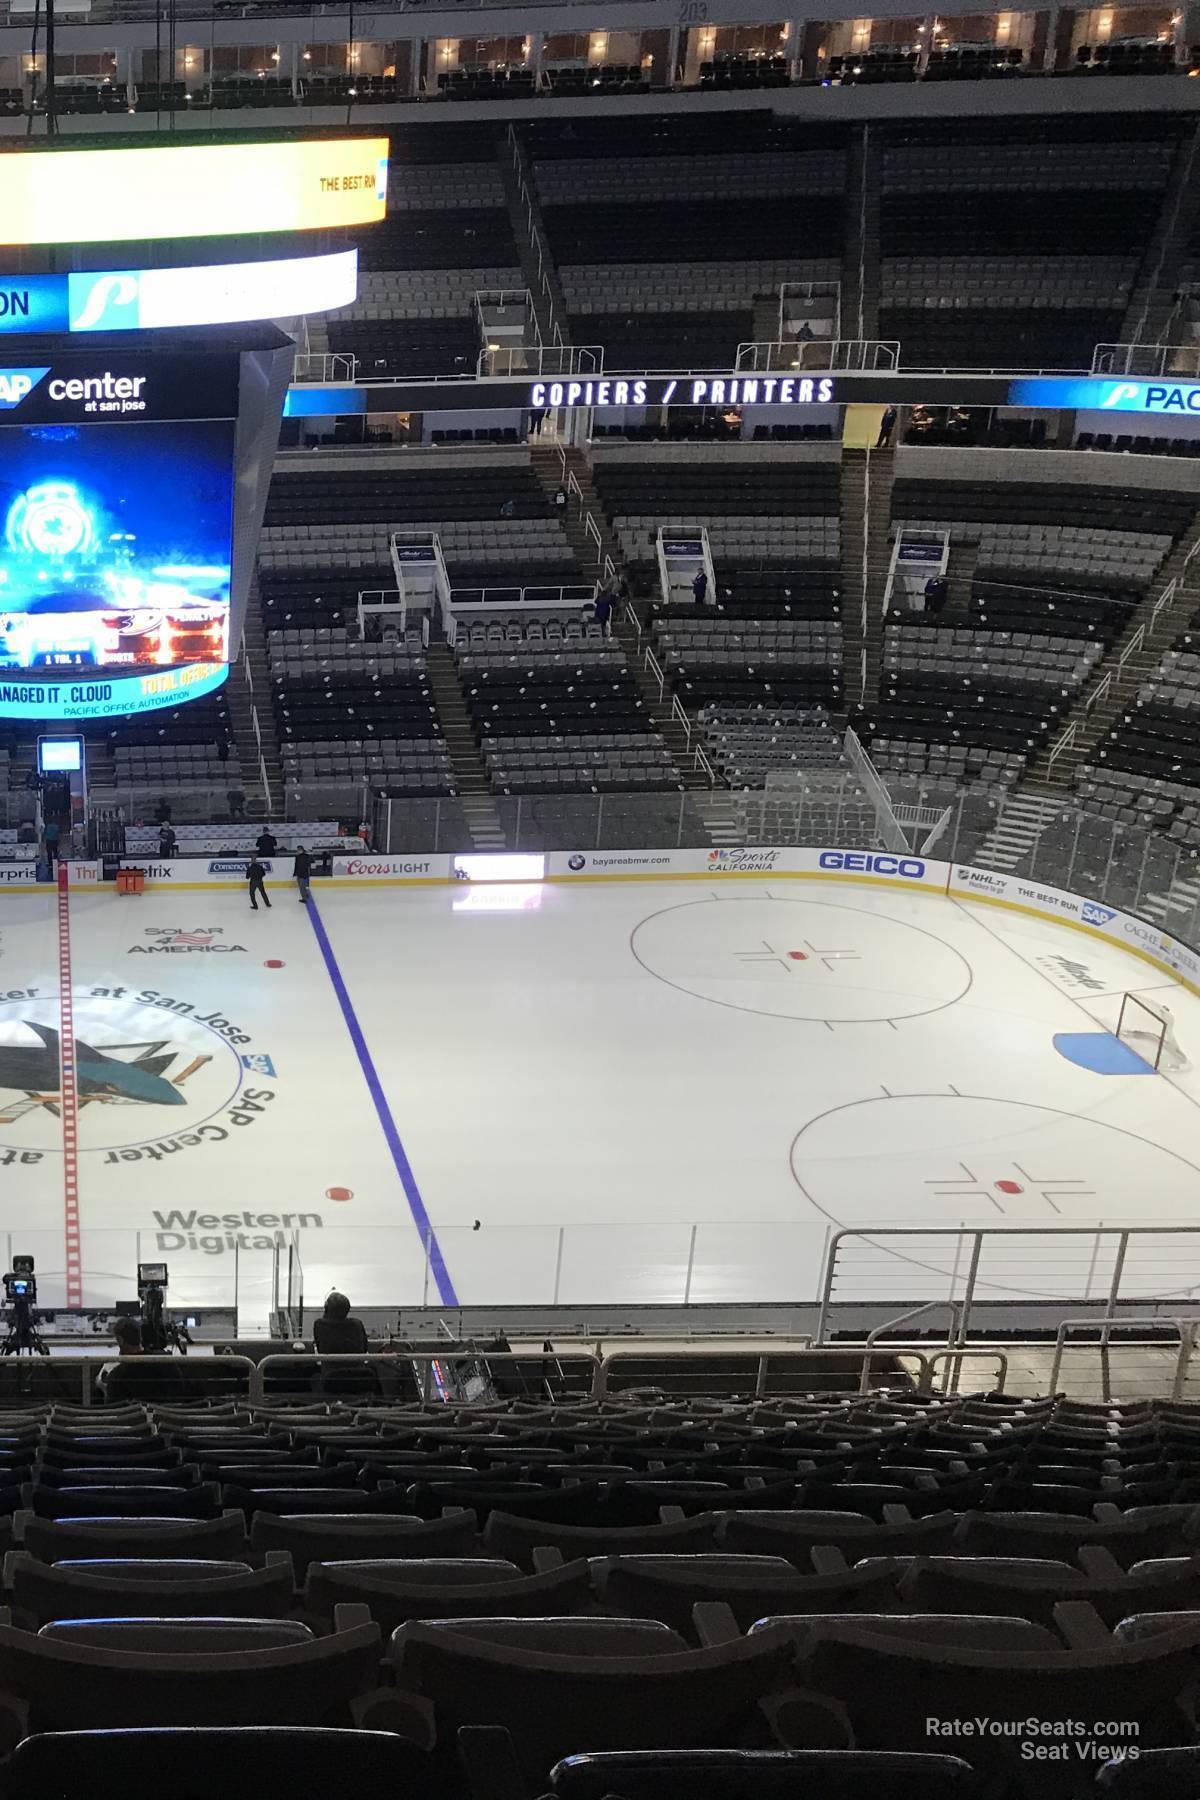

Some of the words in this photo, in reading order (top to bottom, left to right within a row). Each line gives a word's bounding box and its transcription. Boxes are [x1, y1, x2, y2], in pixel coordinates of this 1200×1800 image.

[319, 177, 339, 192] THE
[342, 175, 362, 190] BEST
[48, 371, 147, 401] center
[531, 381, 647, 407] COPIERS
[692, 378, 834, 404] PRINTERS
[84, 400, 97, 412] at
[99, 401, 120, 411] san
[120, 398, 146, 412] jose
[48, 687, 60, 703] IT
[71, 684, 112, 703] CLOUD
[64, 705, 100, 716] PACIFIC
[103, 702, 135, 714] OFFICE
[138, 690, 190, 708] AUTOMATION
[592, 856, 670, 866] bayareabmw.com
[728, 848, 780, 863] Sports
[818, 851, 925, 879] GEICO
[347, 859, 391, 875] Coors
[392, 862, 430, 873] LIGHT
[708, 863, 773, 871] CALIFORNIA
[1017, 887, 1036, 899] THE
[1036, 893, 1060, 905] BEST
[1060, 900, 1079, 912] RUN
[1082, 905, 1109, 925] SAP
[144, 927, 224, 935] SOLAR
[127, 945, 249, 954] AMERICA
[90, 987, 128, 999] at
[134, 990, 195, 1014] San
[194, 1012, 252, 1045] Jose
[227, 1088, 276, 1126] SAP
[104, 1125, 229, 1164] Center
[0, 1149, 44, 1166] at
[152, 1210, 323, 1230] Western
[155, 1230, 288, 1255] Digital
